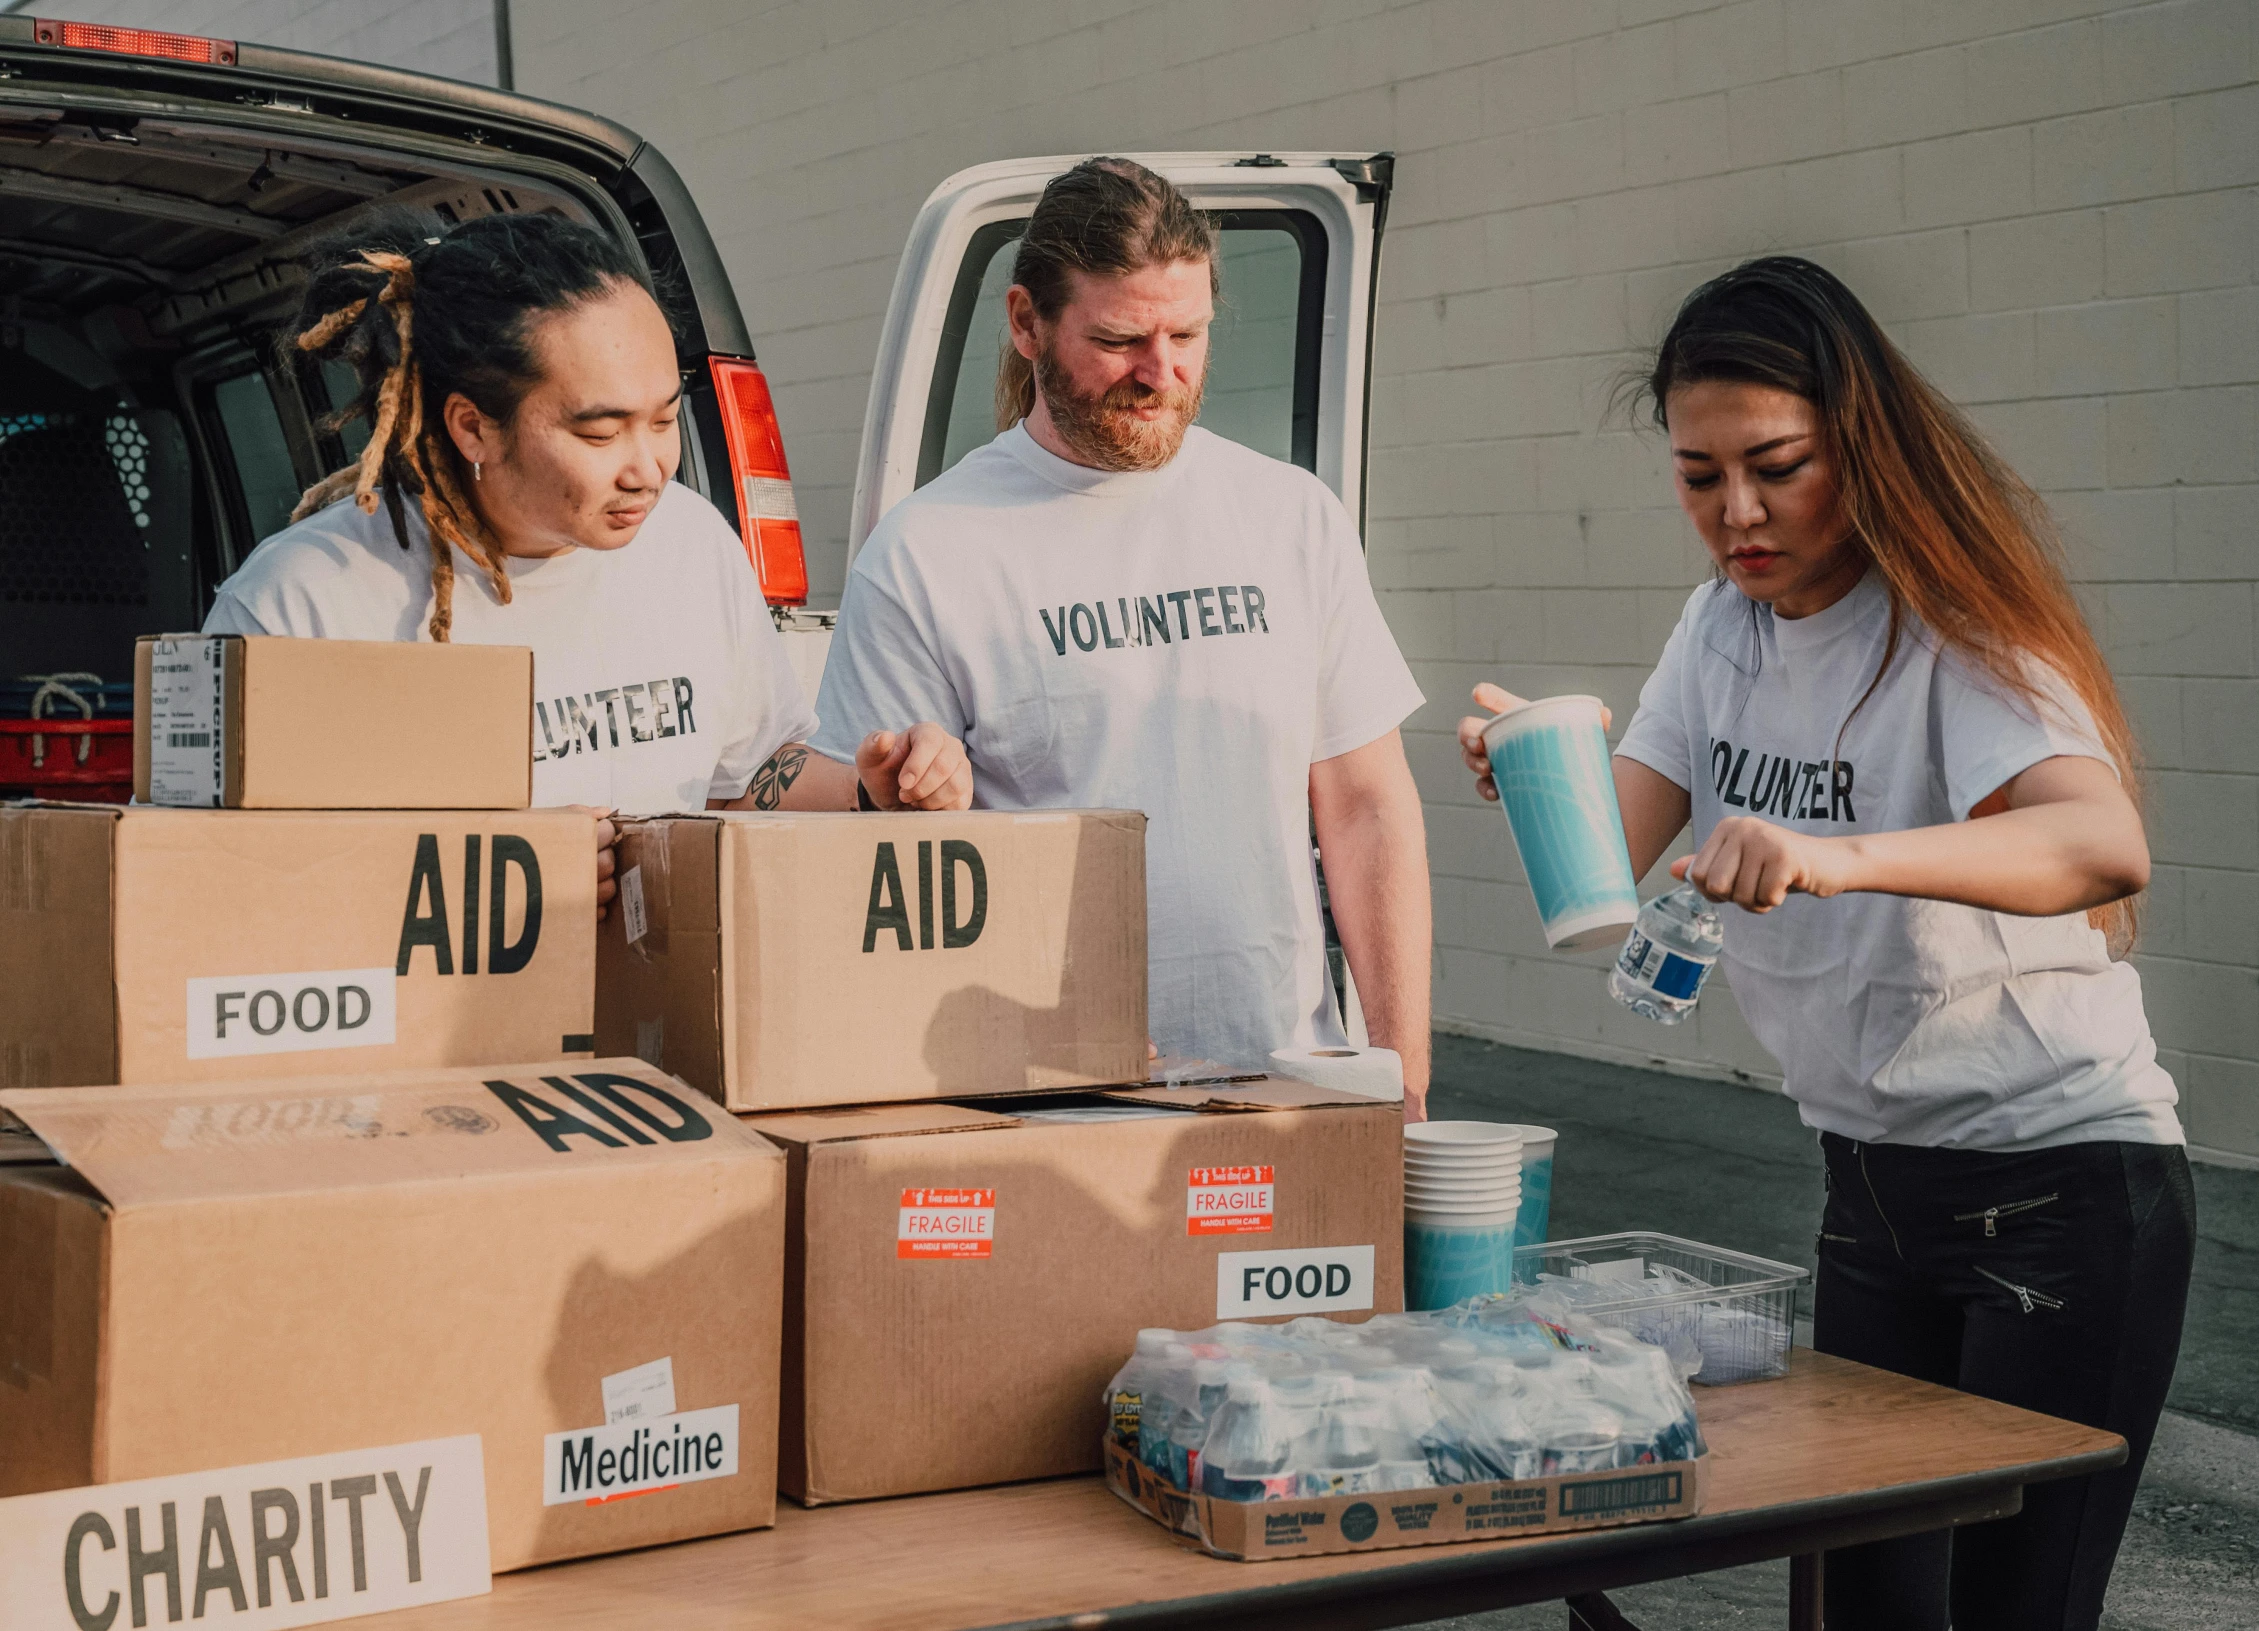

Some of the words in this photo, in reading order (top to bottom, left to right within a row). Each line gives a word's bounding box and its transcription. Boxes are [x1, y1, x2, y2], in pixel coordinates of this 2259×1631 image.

[1038, 585, 1270, 656] VOLUNTEER
[396, 833, 543, 976] AID
[862, 839, 988, 953] AID
[215, 985, 372, 1039] FOOD
[482, 1073, 714, 1152] AID
[908, 1216, 986, 1233] FRAGILE
[1196, 1191, 1267, 1211] FRAGILE
[1200, 1219, 1226, 1227] HANDLE
[1226, 1218, 1242, 1226] WITH
[1242, 1217, 1260, 1225] CARE
[912, 1243, 940, 1251] HANDLE
[941, 1243, 958, 1251] WITH
[959, 1243, 978, 1251] CARE
[1241, 1263, 1352, 1302] FOOD
[560, 1423, 724, 1493] Medicine
[64, 1466, 432, 1631] CHARITY
